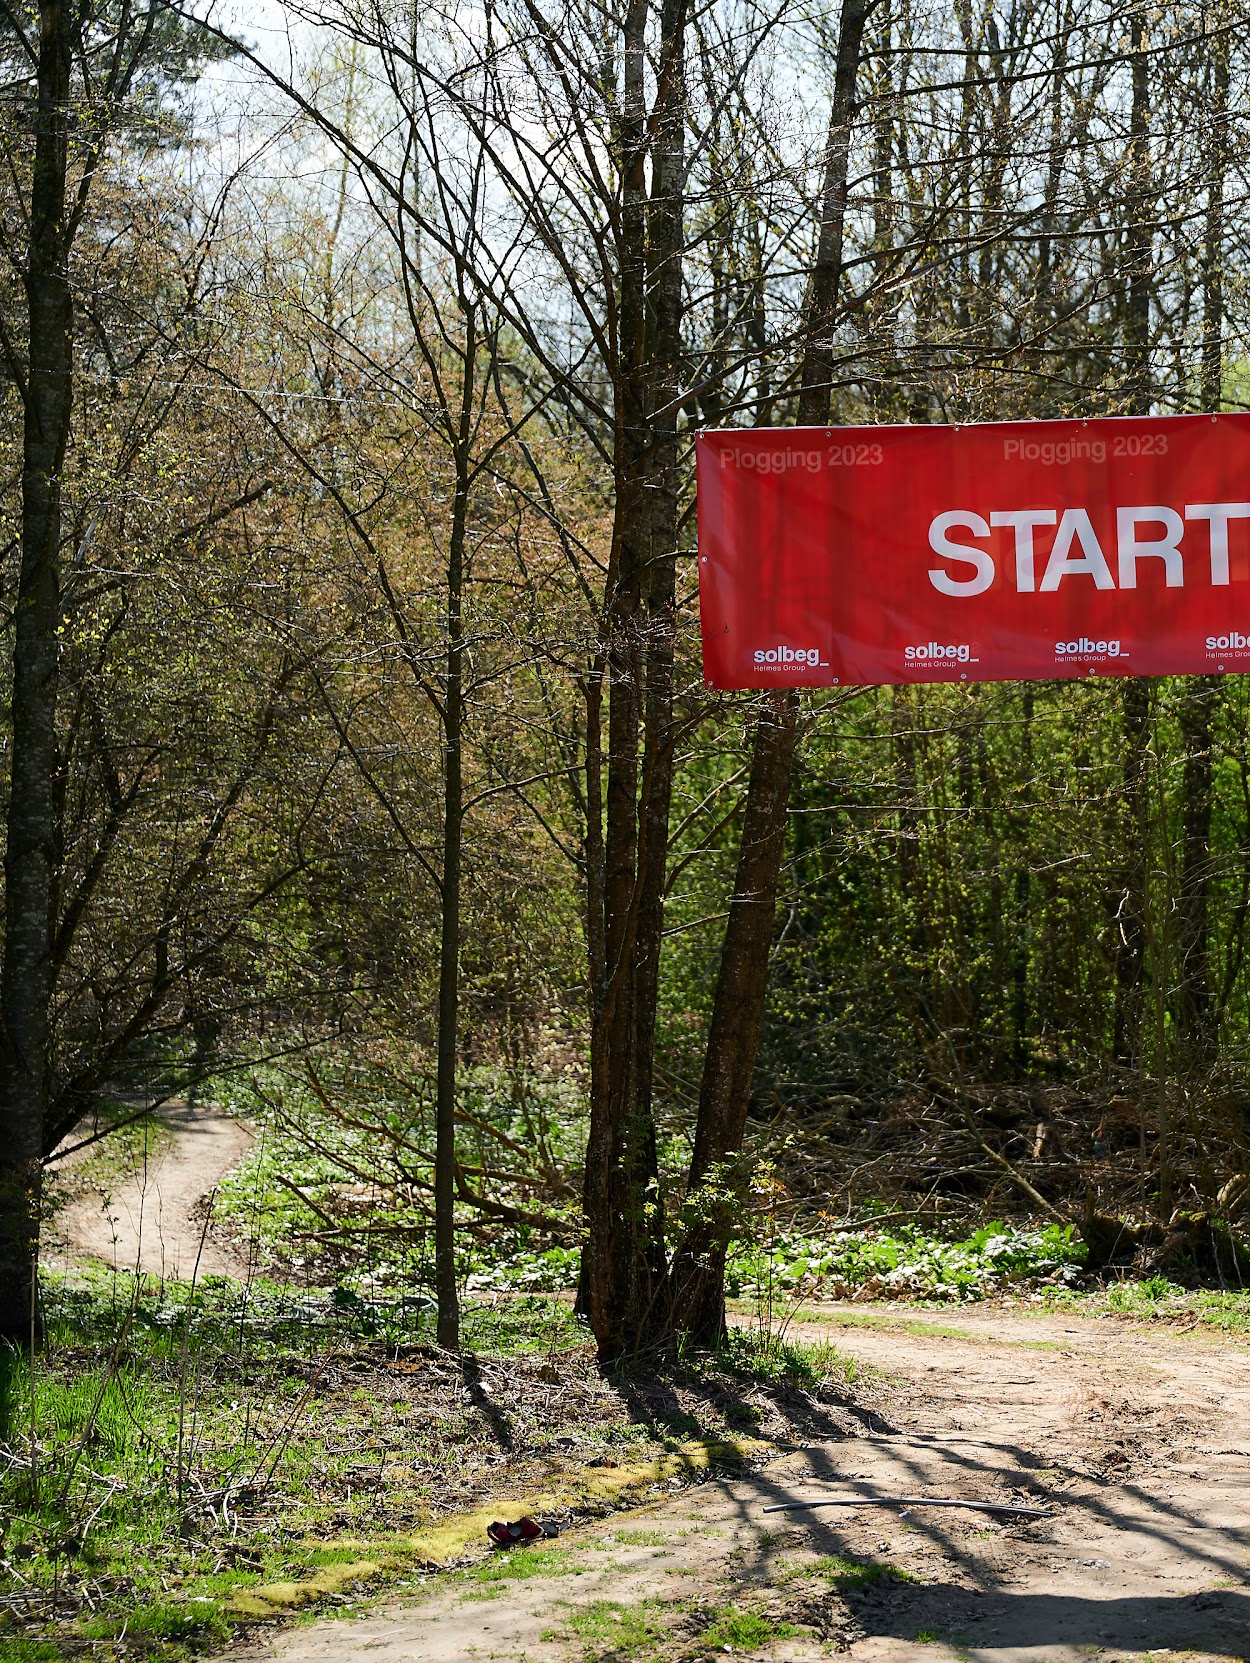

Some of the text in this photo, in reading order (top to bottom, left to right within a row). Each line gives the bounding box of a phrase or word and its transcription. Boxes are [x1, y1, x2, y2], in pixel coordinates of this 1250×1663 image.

[719, 443, 883, 474] Plogging 2023
[1003, 433, 1168, 465] Plogging 2023
[782, 664, 806, 672] Group
[933, 660, 957, 668] Group
